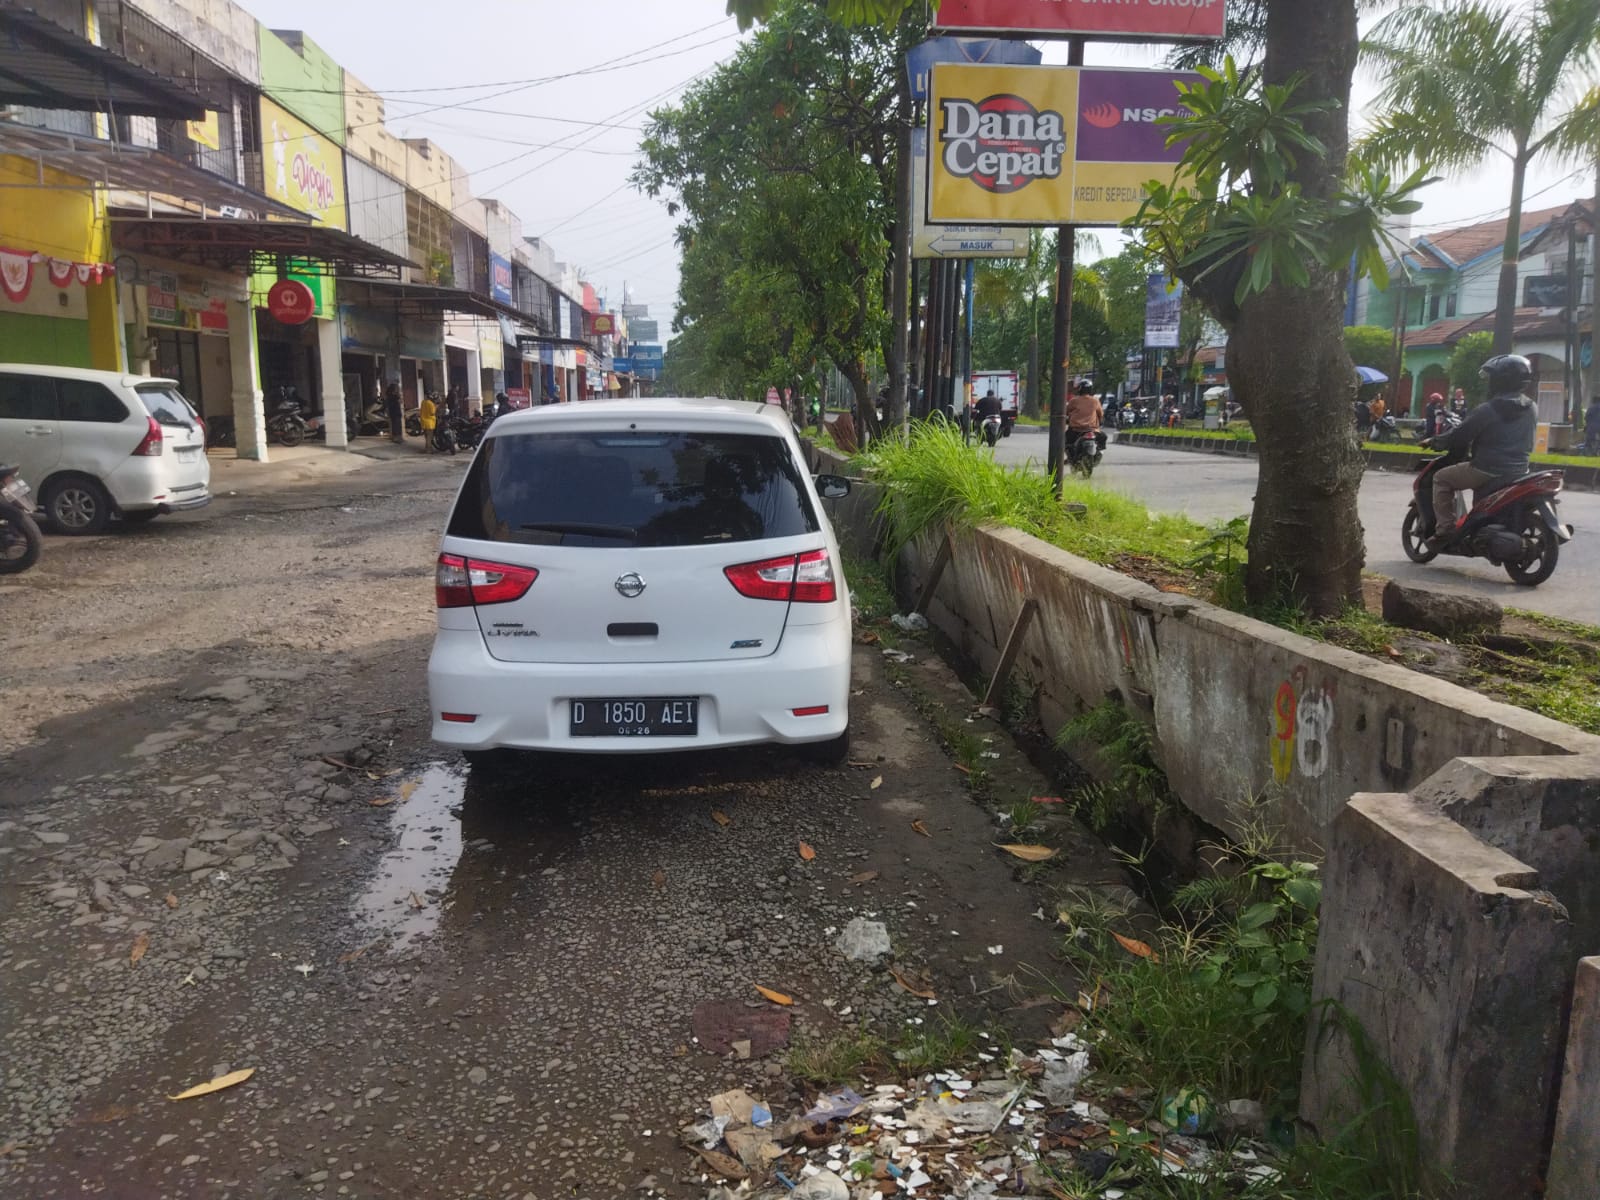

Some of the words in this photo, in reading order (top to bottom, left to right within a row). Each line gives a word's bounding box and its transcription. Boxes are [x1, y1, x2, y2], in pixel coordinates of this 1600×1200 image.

[942, 101, 1062, 141] Dana
[1123, 108, 1174, 122] NSC
[945, 138, 1059, 185] Cepat
[1074, 186, 1103, 201] KREDIT
[1105, 187, 1137, 202] SEPEDA
[960, 241, 994, 249] MASUK
[574, 702, 585, 724] D
[604, 702, 646, 724] 1850
[661, 702, 693, 724] AEI
